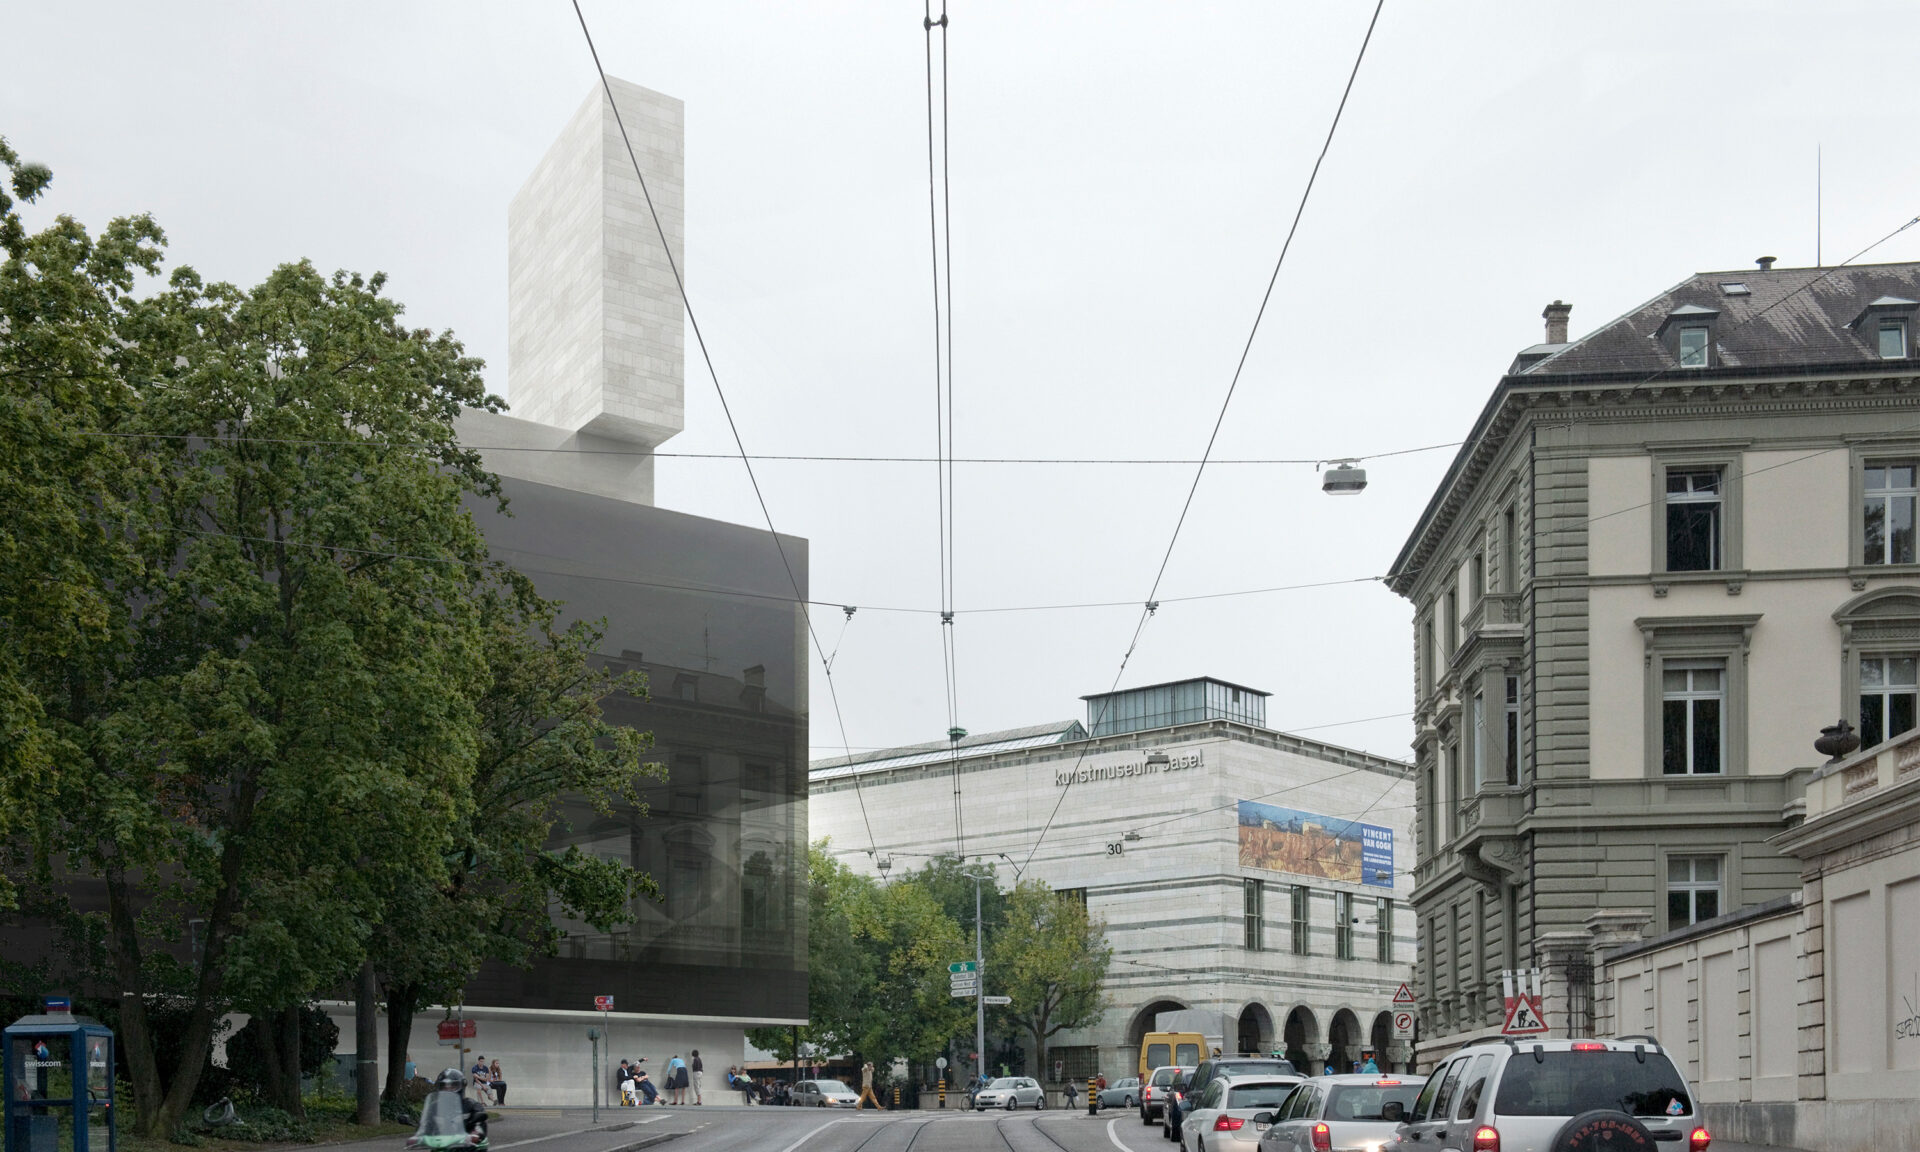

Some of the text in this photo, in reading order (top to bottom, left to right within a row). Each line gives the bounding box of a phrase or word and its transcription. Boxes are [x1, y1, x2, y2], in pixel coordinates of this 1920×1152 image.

[1363, 828, 1391, 841] VINCENT
[1107, 843, 1122, 855] 30
[1363, 838, 1391, 850] VAN GOGH
[24, 1060, 62, 1068] swisscom
